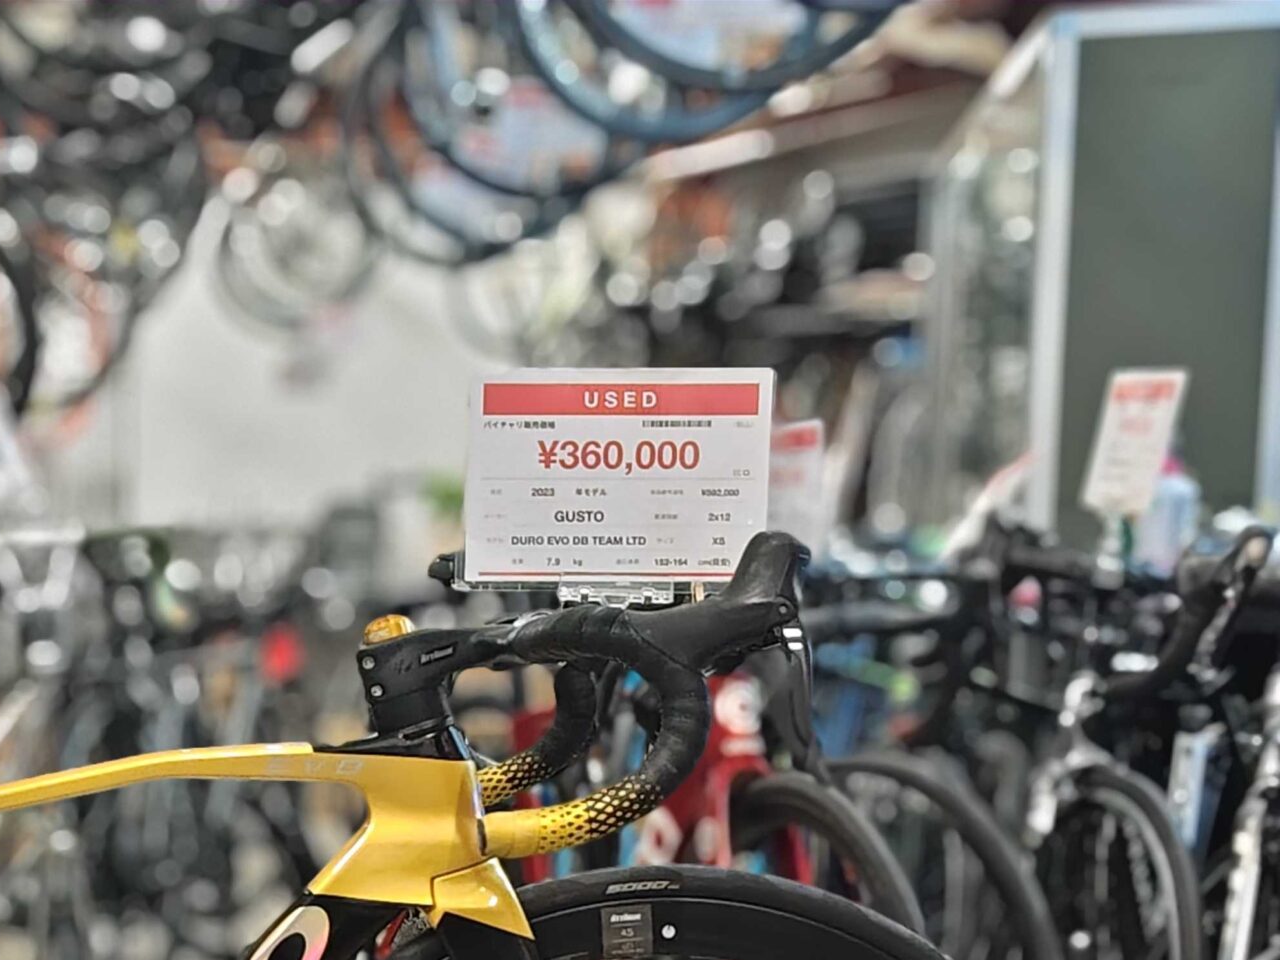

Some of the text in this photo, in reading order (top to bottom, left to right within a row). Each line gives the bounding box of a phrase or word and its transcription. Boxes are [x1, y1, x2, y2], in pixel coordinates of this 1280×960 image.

[583, 391, 658, 408] USED
[537, 440, 700, 475] ¥360,000
[531, 487, 555, 497] 2023
[554, 511, 605, 523] GUSTO
[511, 536, 545, 546] DURO
[547, 536, 570, 546] EVO
[572, 536, 589, 546] DB
[592, 536, 624, 546] TEAM
[626, 536, 647, 546] LTD
